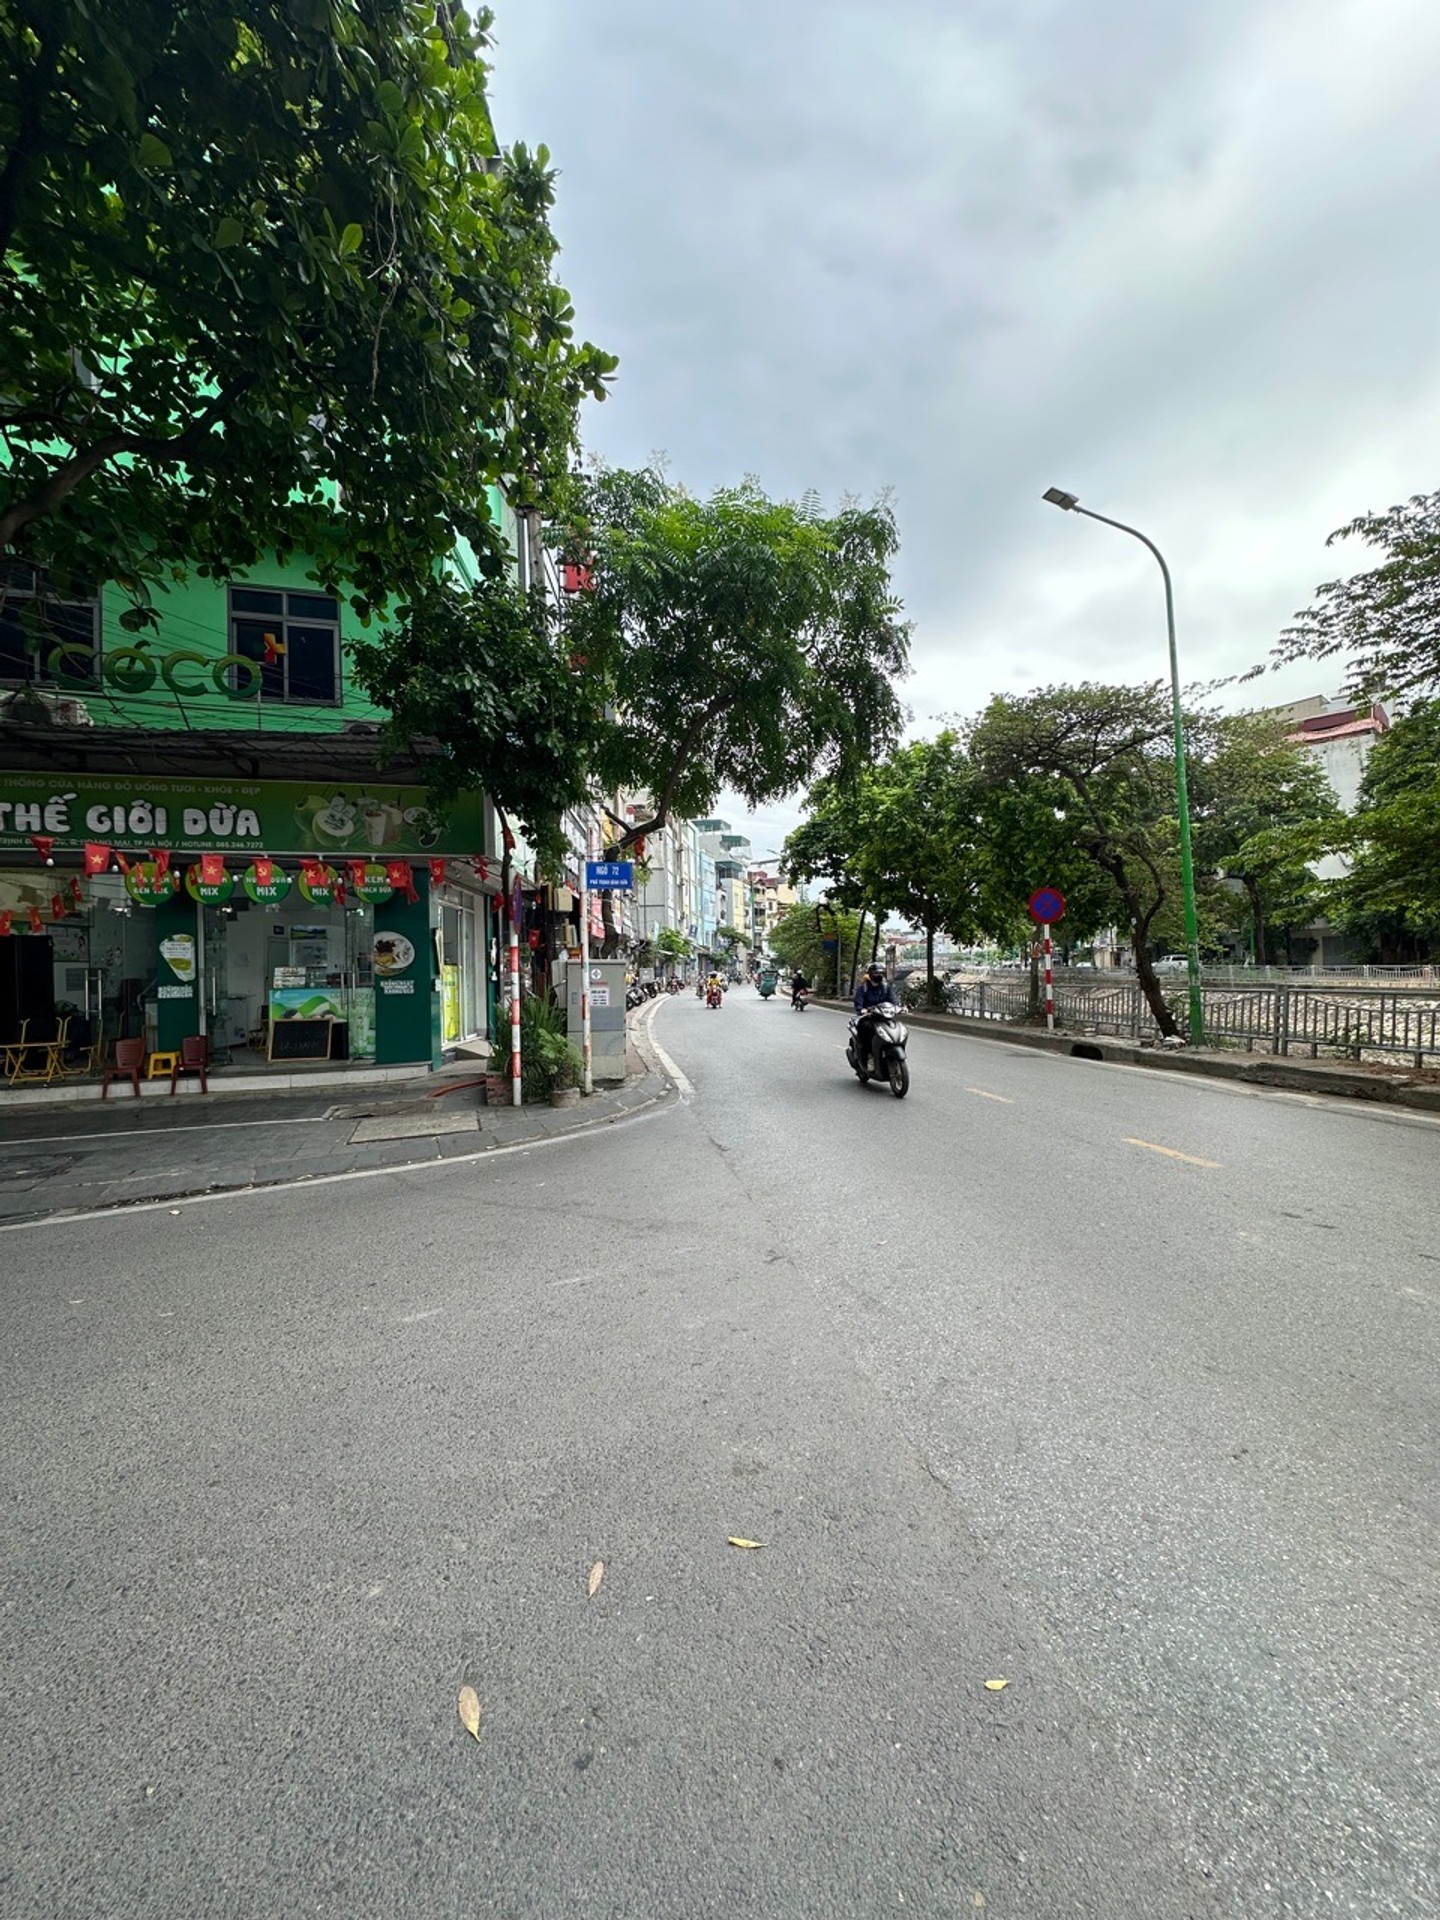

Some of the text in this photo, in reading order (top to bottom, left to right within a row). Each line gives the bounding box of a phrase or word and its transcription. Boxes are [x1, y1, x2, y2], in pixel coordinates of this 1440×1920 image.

[48, 778, 74, 788] CỦA
[77, 779, 110, 790] HÀNG
[135, 780, 168, 791] UỐNG
[86, 799, 167, 835] GIỚI
[183, 802, 260, 836] DỪA
[158, 839, 172, 848] NỘI
[611, 866, 619, 875] 72
[200, 887, 219, 896] MIX
[256, 886, 277, 896] MIX
[312, 887, 329, 896] MIX
